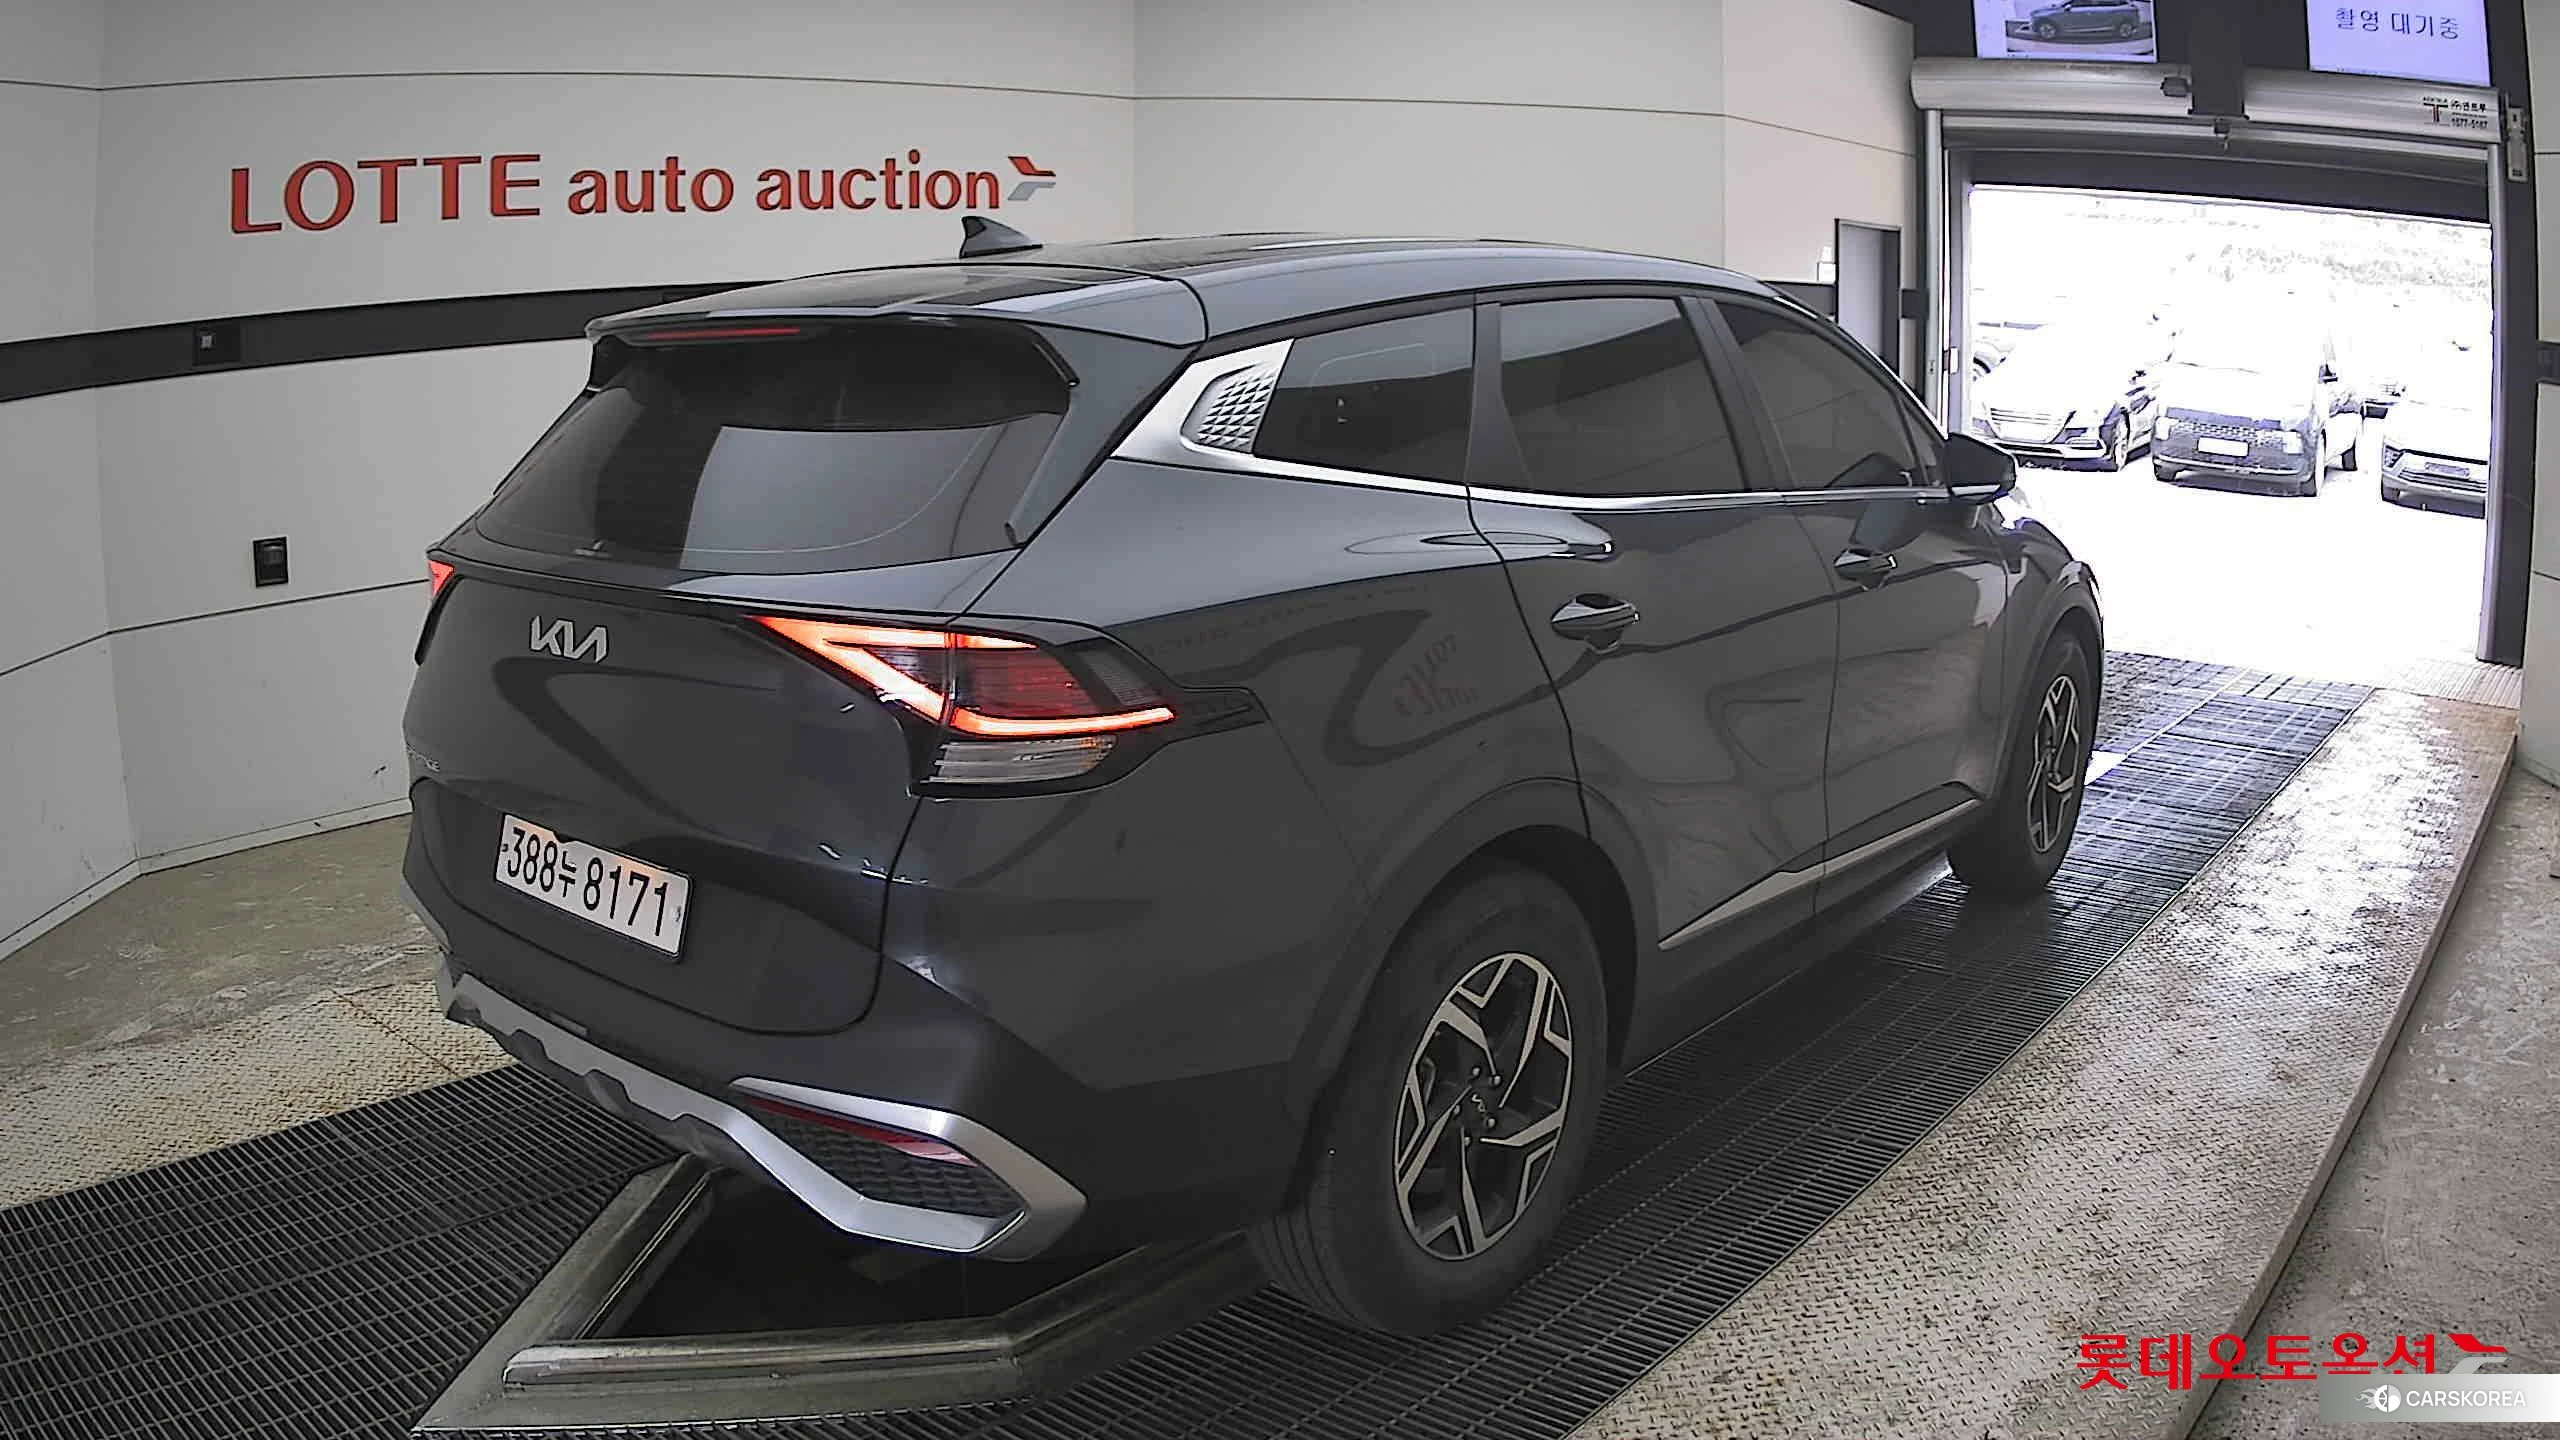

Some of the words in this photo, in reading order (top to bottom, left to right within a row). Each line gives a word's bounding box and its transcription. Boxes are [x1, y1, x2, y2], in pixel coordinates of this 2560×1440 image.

[2336, 7, 2380, 33] 촬영
[2391, 12, 2459, 40] 대기중
[230, 153, 543, 235] LOTTE
[567, 155, 735, 214] auto
[755, 150, 1001, 210] auction
[507, 826, 577, 898] 388누
[583, 857, 668, 936] 8171
